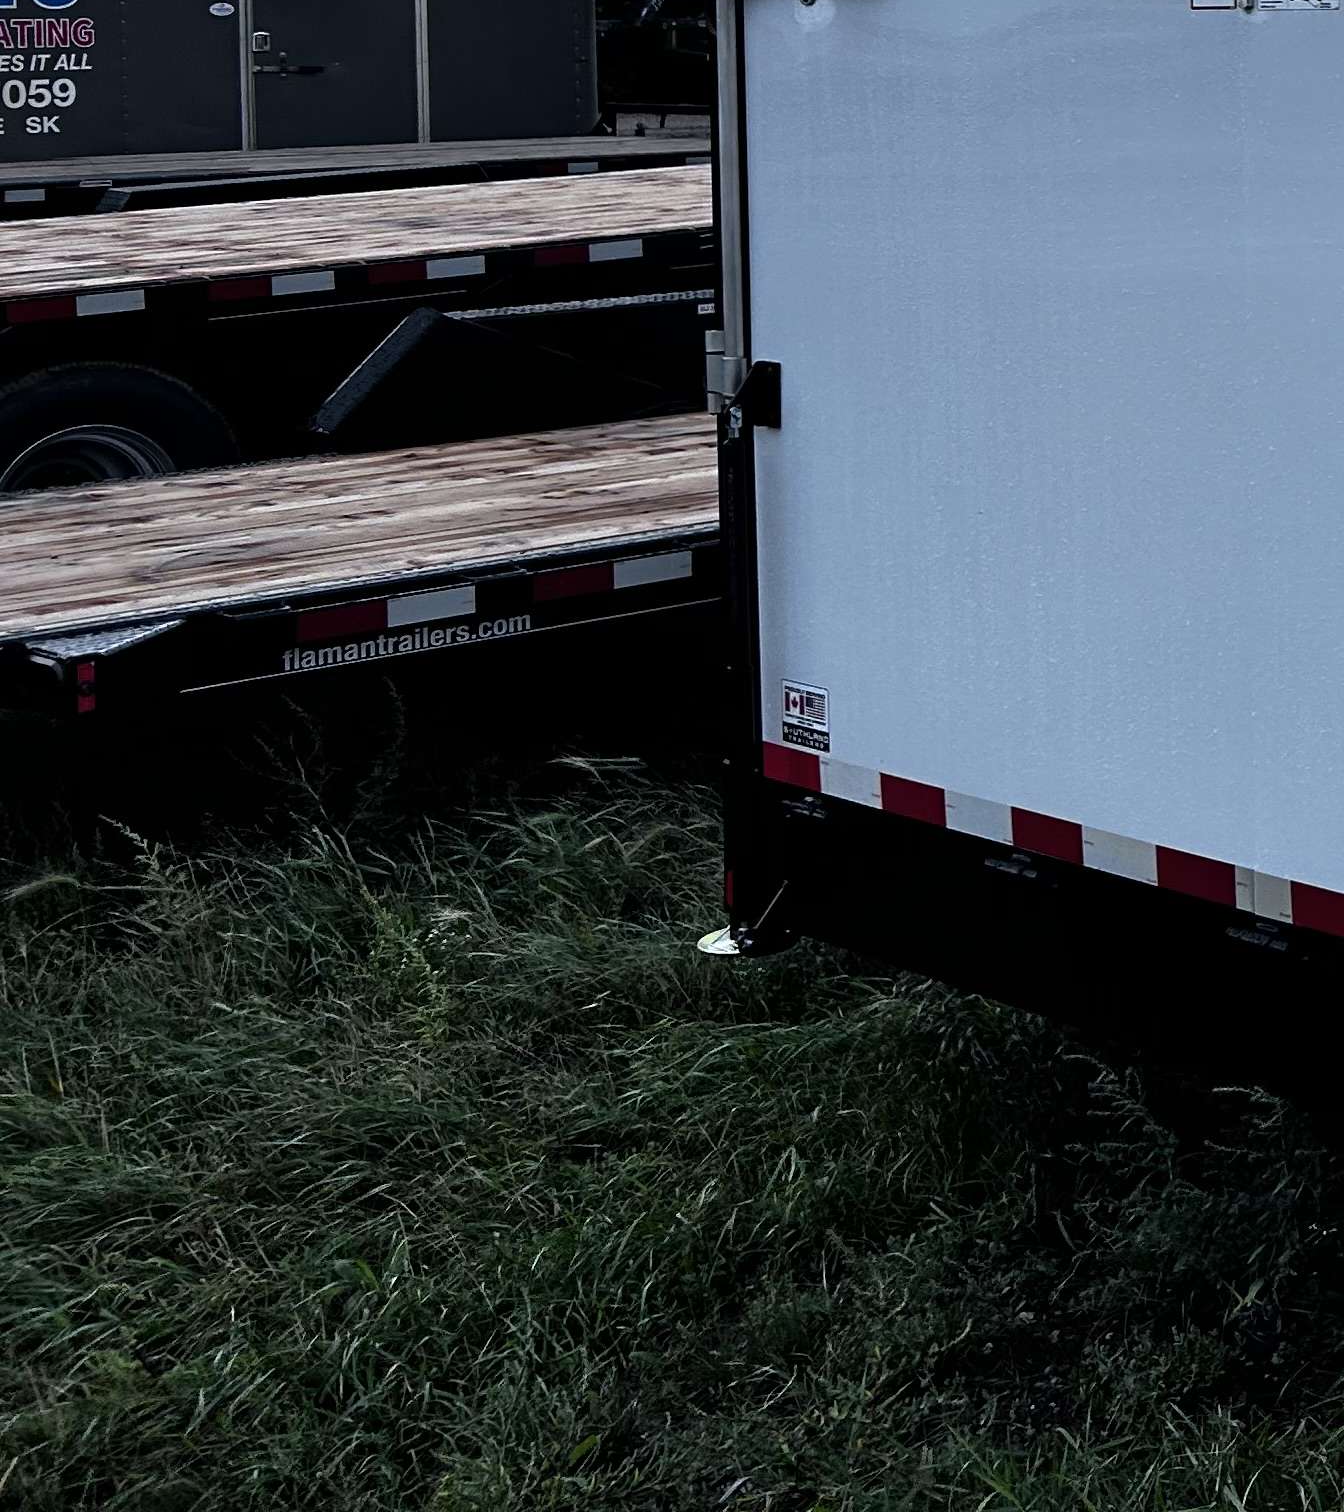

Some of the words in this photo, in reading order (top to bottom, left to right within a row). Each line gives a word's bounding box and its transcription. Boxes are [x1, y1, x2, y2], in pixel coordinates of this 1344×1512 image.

[30, 54, 50, 71] IT
[54, 53, 93, 71] ALL
[2, 78, 76, 109] 059
[25, 116, 60, 134] SK
[282, 614, 531, 671] flamantrailers.com
